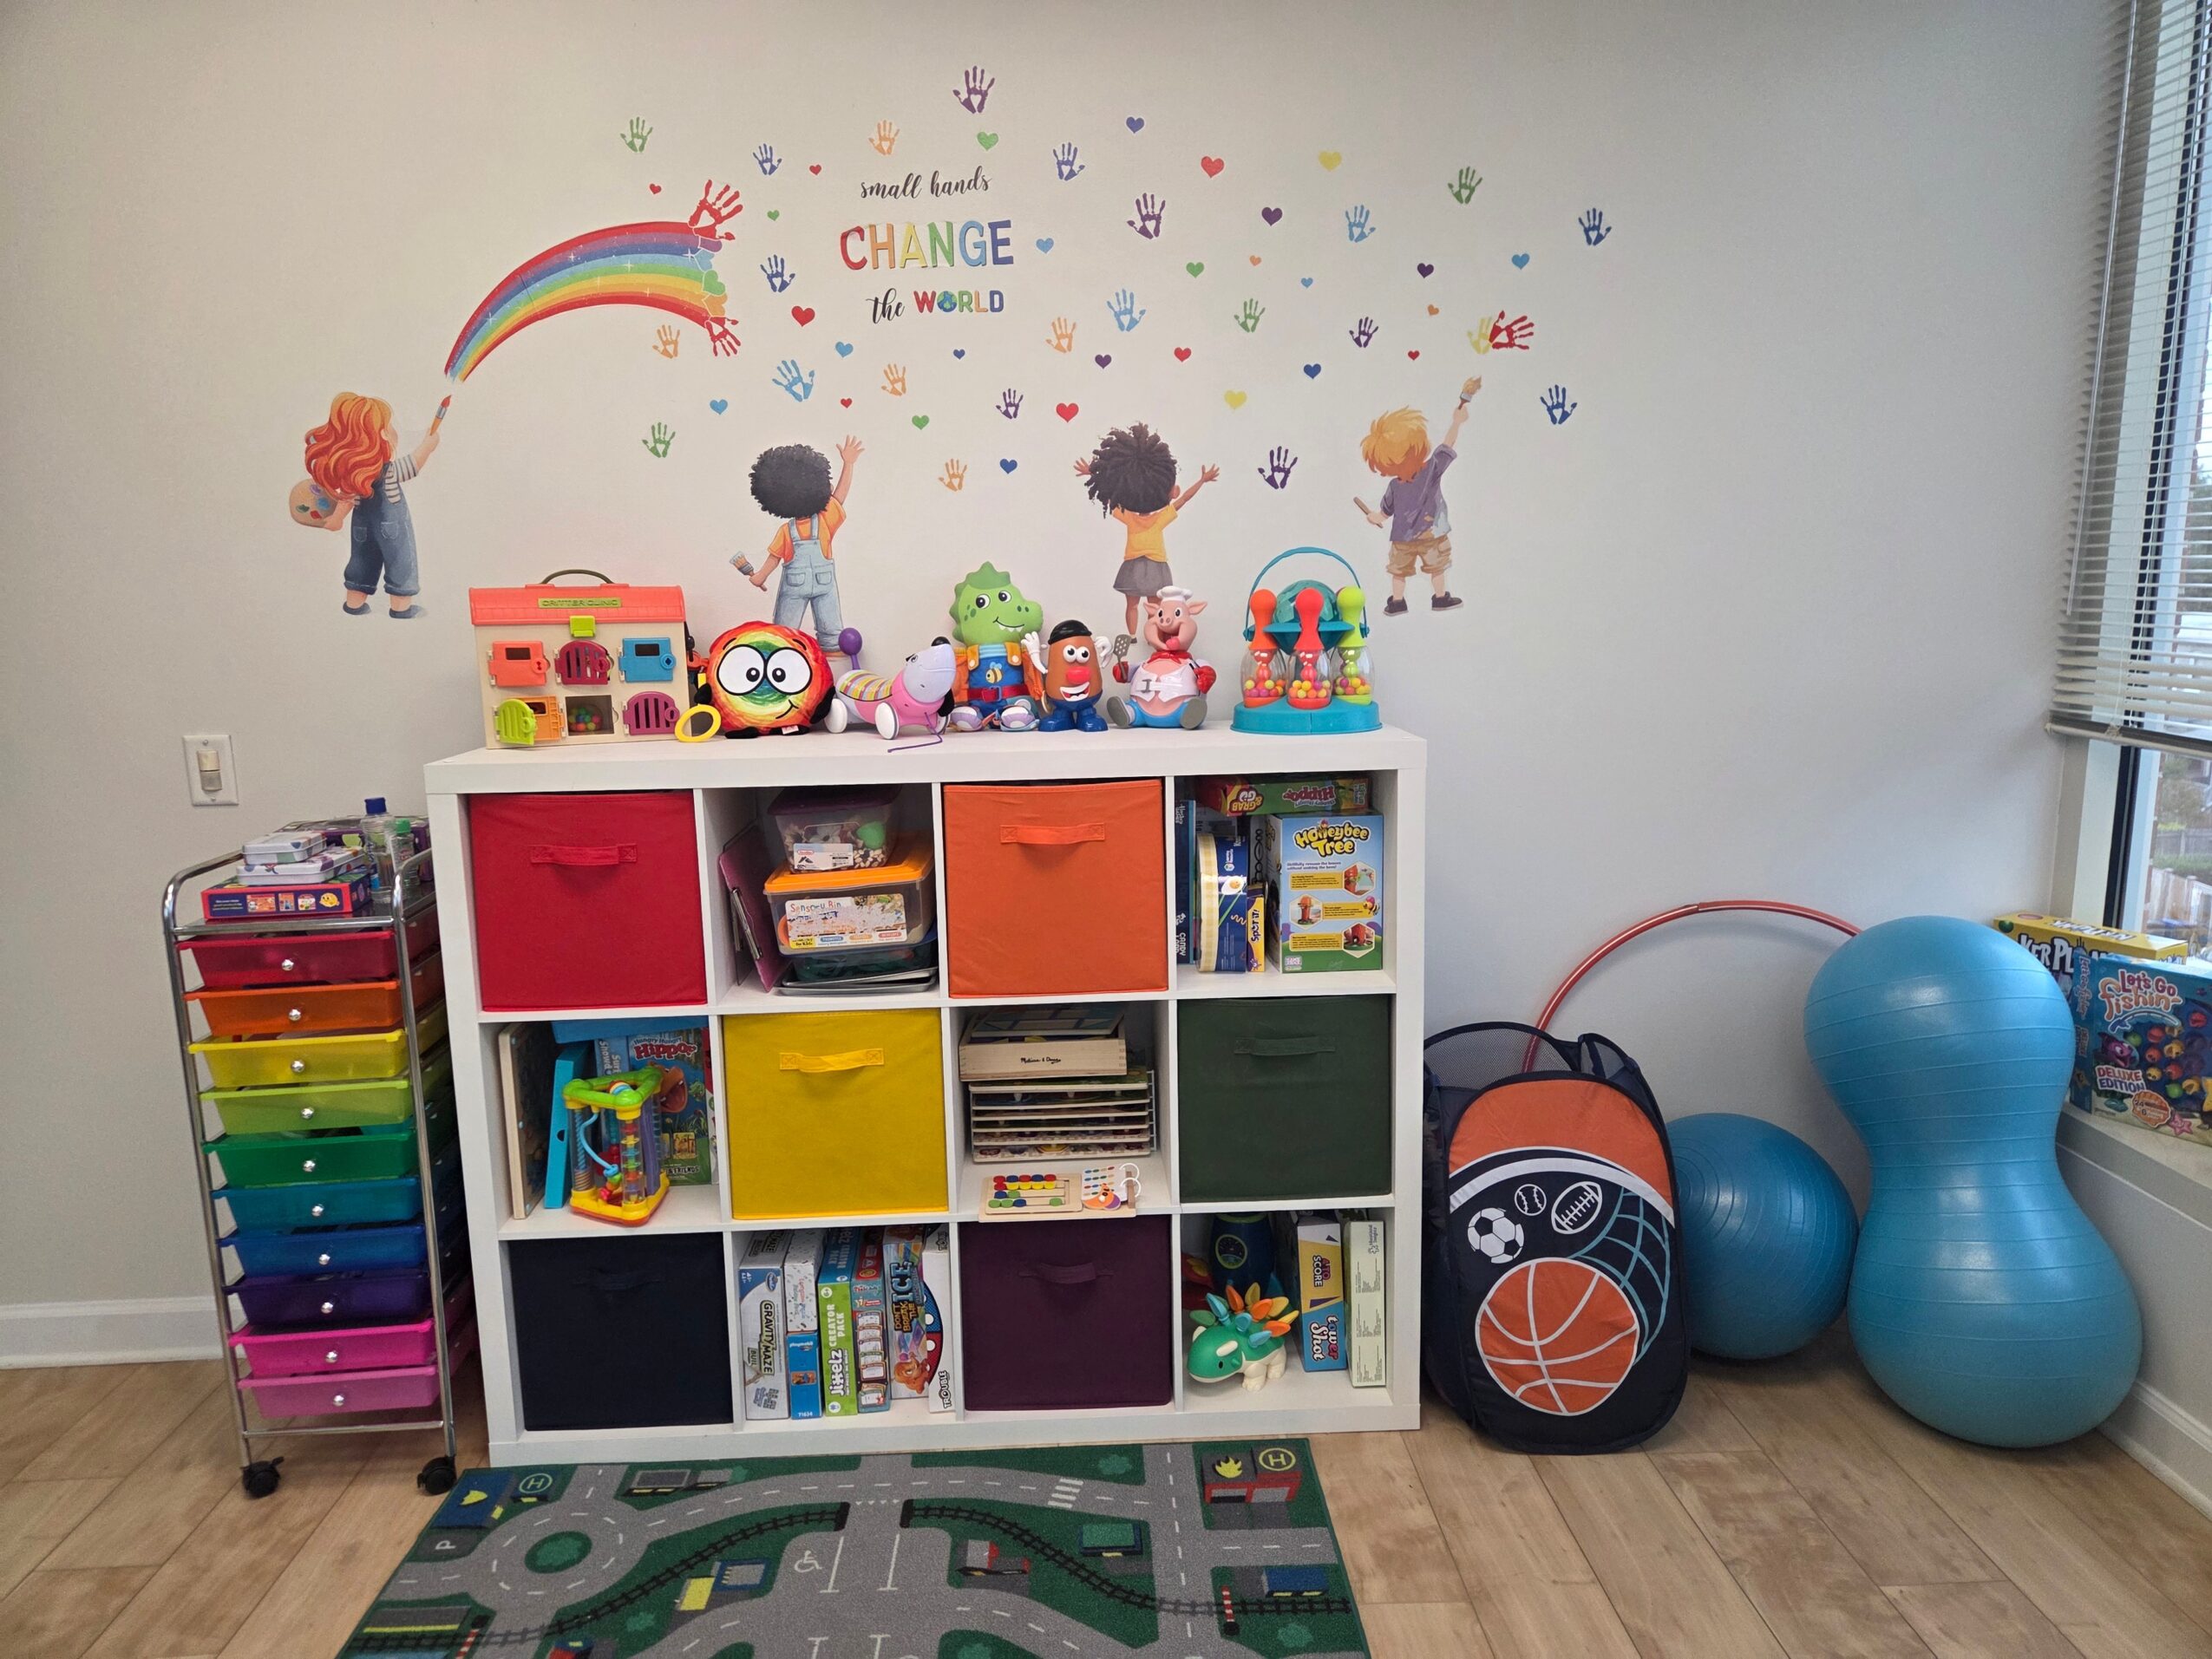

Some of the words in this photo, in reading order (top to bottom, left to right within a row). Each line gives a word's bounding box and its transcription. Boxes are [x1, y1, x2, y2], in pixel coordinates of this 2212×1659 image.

[861, 173, 922, 199] small
[930, 165, 992, 198] hands
[840, 219, 1014, 271] CHANGE
[866, 288, 905, 324] the
[913, 291, 1005, 314] WORLD
[1295, 822, 1370, 848] Honeybee
[1310, 839, 1355, 857] Tree
[2119, 970, 2151, 992] Let's
[2155, 977, 2176, 996] Go
[2097, 1066, 2141, 1081] DELUXE
[2099, 1078, 2145, 1093] EDITION
[891, 1262, 913, 1303] ICE
[1313, 1256, 1322, 1286] SCORE
[764, 1303, 775, 1347] GRAVITY
[827, 1304, 836, 1348] CREATOR
[836, 1313, 845, 1338] PACK
[900, 1302, 911, 1332] BREAK
[1311, 1323, 1325, 1360] Shot
[1327, 1316, 1338, 1360] tower
[762, 1344, 773, 1374] MAZE
[939, 1370, 952, 1408] TROUBLE
